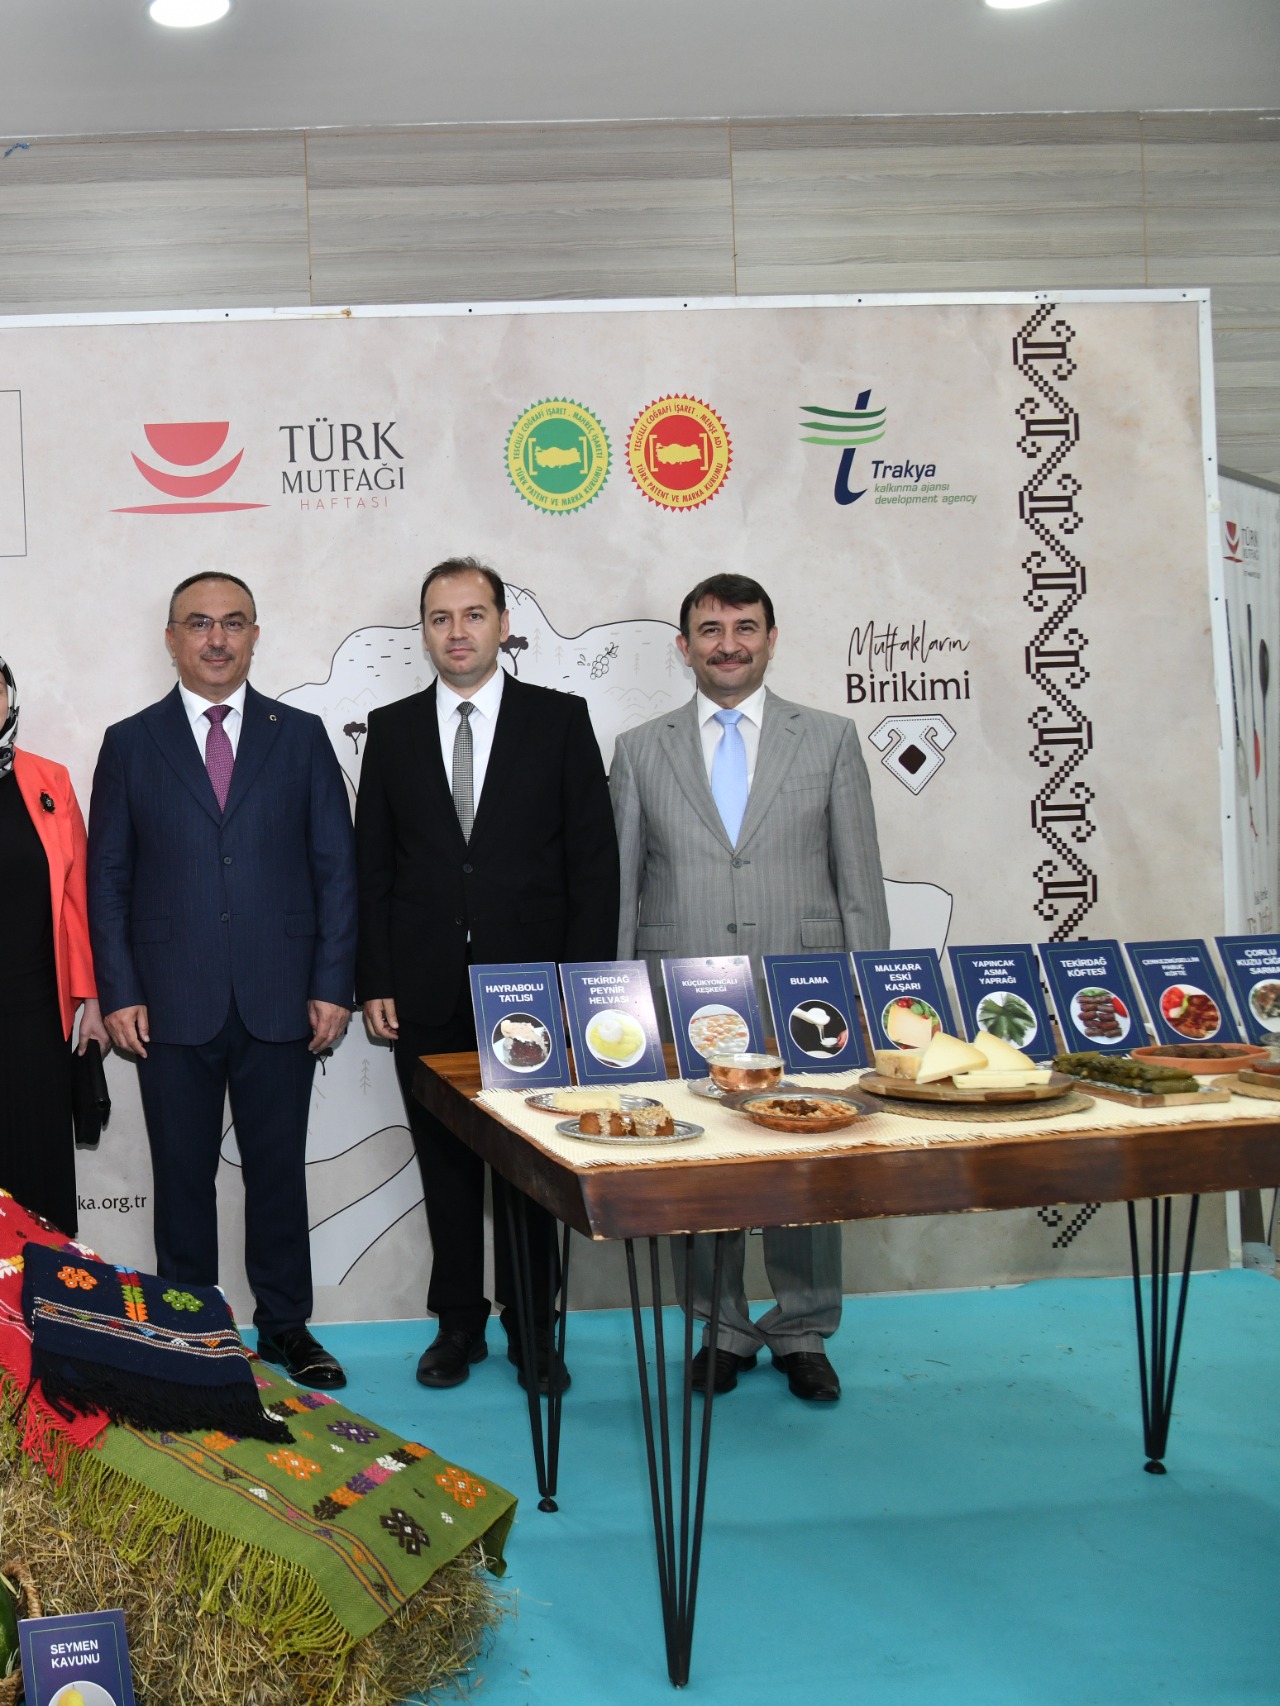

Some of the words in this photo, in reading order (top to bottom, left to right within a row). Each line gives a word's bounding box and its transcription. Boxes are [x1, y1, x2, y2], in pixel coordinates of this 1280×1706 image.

[279, 417, 405, 463] TÜRK
[871, 459, 937, 483] Trakya
[282, 462, 405, 494] MUTFAĞI
[637, 463, 649, 483] TÜRK
[647, 482, 670, 500] PATENT
[671, 494, 680, 503] VE
[682, 489, 705, 503] MARKA
[705, 462, 724, 491] KURUMU
[526, 485, 548, 503] PATENT
[551, 497, 559, 506] VE
[561, 492, 584, 506] MARKA
[584, 466, 603, 494] KURUMU
[874, 482, 918, 494] kalkınma
[921, 482, 950, 495] ajansı
[300, 496, 388, 511] HAFTASI
[875, 494, 938, 506] development
[942, 493, 977, 505] agency
[848, 620, 971, 672] Mutfakların
[846, 670, 971, 704] Birikimi
[874, 963, 921, 973] MALKARA
[972, 959, 1016, 968] YAPINCAK
[1060, 956, 1107, 968] TEKİRDAĞ
[889, 972, 912, 982] ESKİ
[983, 968, 1009, 976] ASMA
[1067, 966, 1107, 978] KÖFTESİ
[581, 974, 630, 985] TEKİRDAĞ
[790, 976, 829, 985] BULAMA
[978, 975, 1017, 985] YAPRAĞI
[485, 982, 544, 993] HAYRABOLU
[590, 984, 625, 995] PEYNİR
[884, 982, 921, 992] KAŞARI
[498, 993, 533, 1003] TATLISI
[589, 995, 630, 1005] HELVASI
[78, 1194, 147, 1213] ka.org.tr
[50, 1639, 99, 1655] SEYMEN
[51, 1653, 100, 1669] KAVUNU
